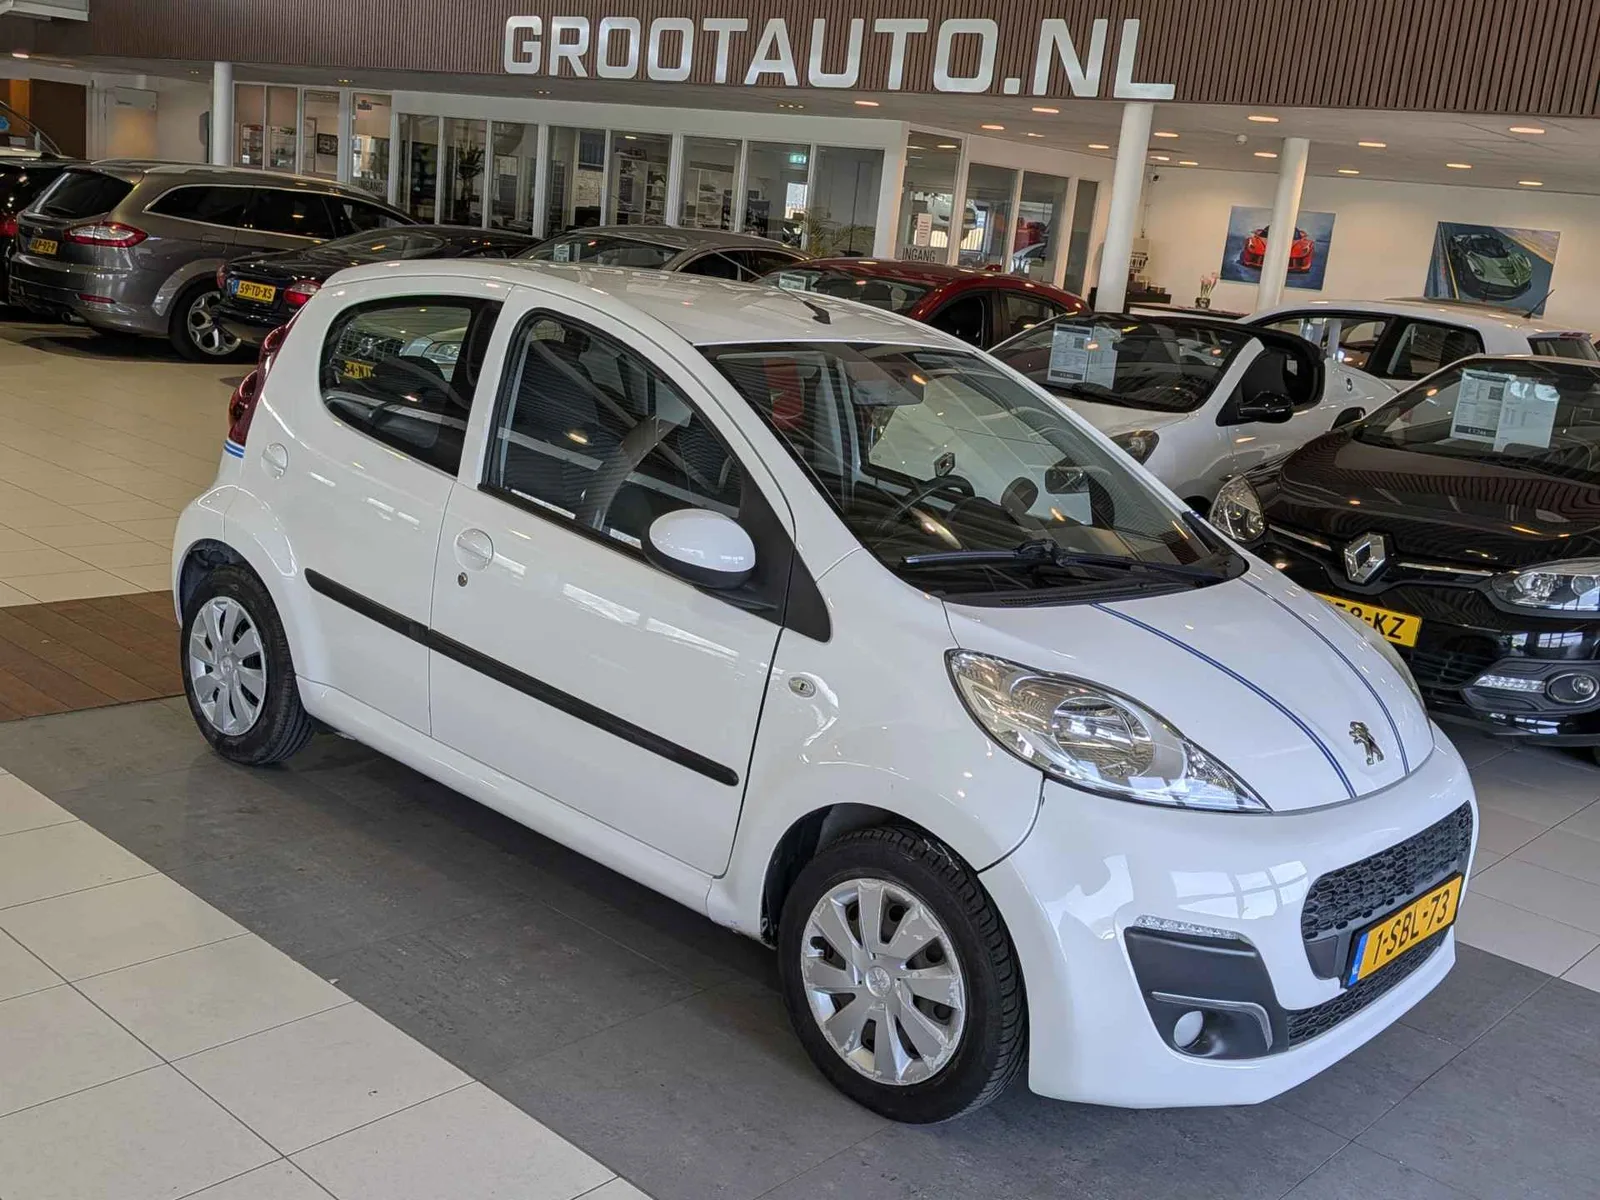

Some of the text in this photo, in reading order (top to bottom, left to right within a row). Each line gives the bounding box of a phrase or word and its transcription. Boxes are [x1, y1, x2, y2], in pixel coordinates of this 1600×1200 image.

[504, 15, 1176, 100] GROOTAUTO.NL
[902, 247, 936, 262] INGANG
[240, 283, 272, 299] 59-TD-XS
[1373, 889, 1450, 965] 1-SBL-73
